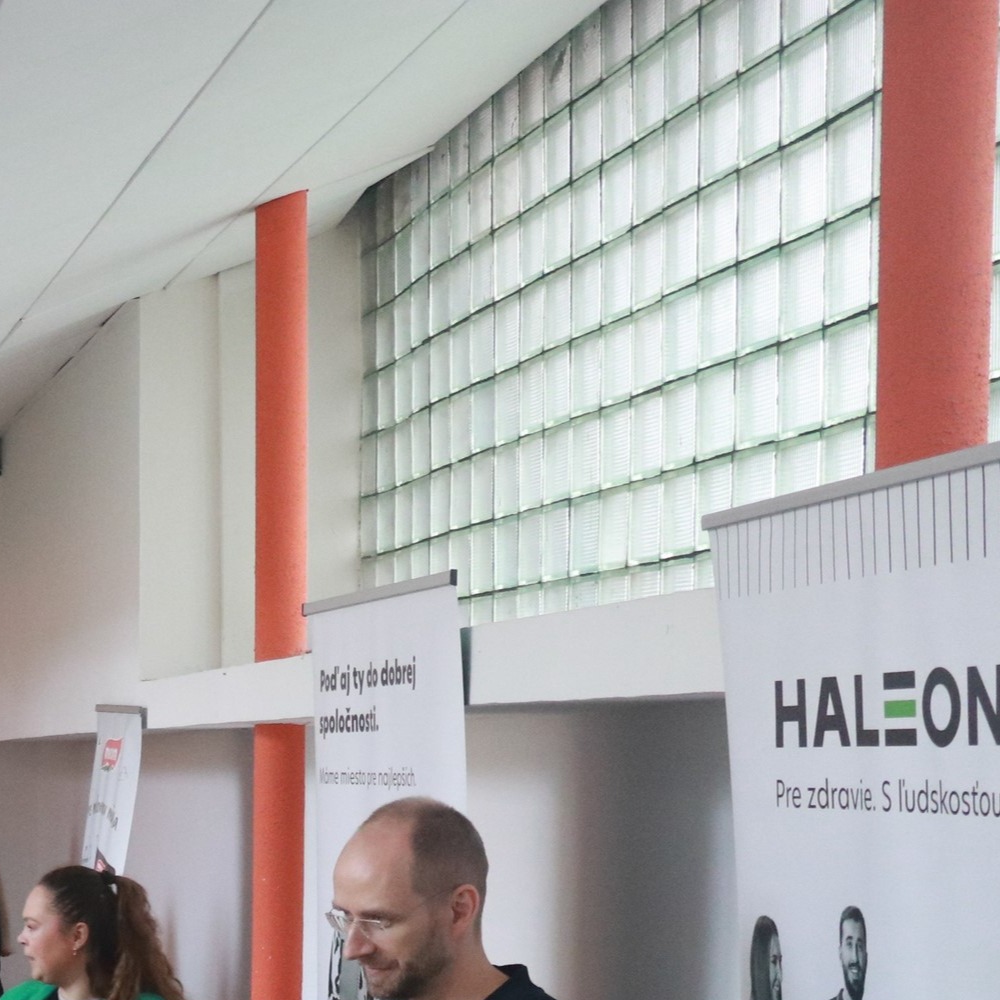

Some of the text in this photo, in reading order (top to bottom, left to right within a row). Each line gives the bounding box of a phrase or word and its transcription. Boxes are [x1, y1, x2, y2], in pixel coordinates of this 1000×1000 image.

[320, 655, 416, 696] Poď aj ty do dobrej
[320, 705, 379, 739] spoločnosti.
[774, 664, 1000, 748] HALEON
[776, 779, 801, 808] Pre
[807, 778, 876, 811] zdravie.
[881, 780, 892, 812] S
